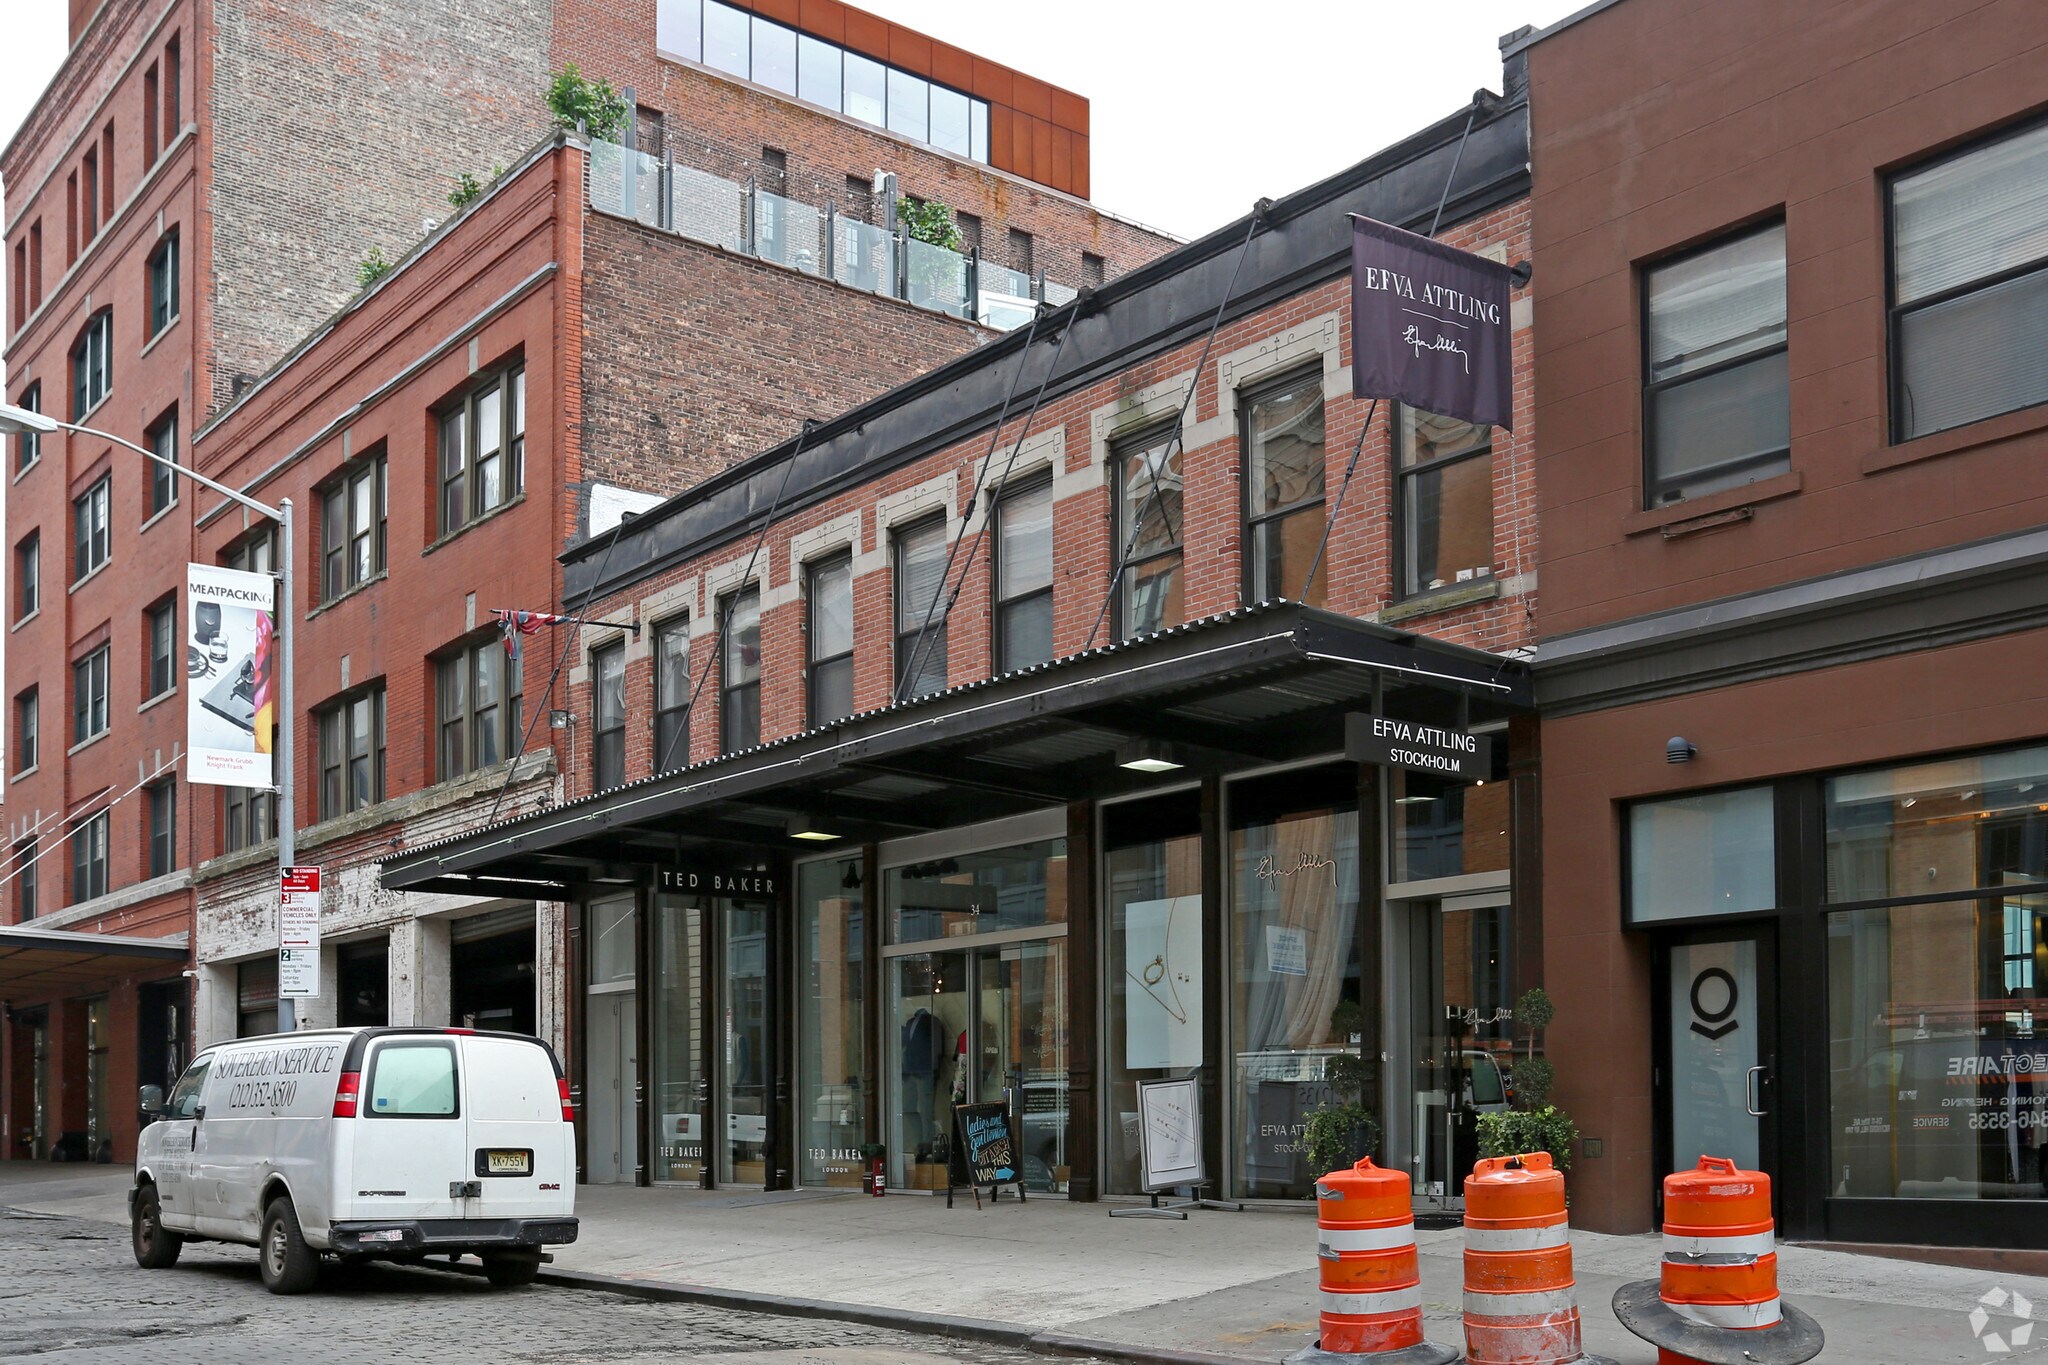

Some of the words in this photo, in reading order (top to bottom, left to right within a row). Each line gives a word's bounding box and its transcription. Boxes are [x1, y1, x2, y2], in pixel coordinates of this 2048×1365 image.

[1365, 266, 1415, 300] EFVA
[1421, 282, 1501, 325] ATTLING
[189, 583, 272, 604] MEATPACKING
[1373, 718, 1412, 742] EFVA
[1415, 726, 1476, 753] ATTLING
[206, 761, 226, 769] Knight
[1390, 748, 1460, 772] STOCKHOLM
[663, 871, 698, 887] TED
[714, 875, 773, 893] BAKER
[283, 893, 290, 903] 3
[970, 904, 980, 916] 34
[283, 950, 289, 960] 2
[214, 1049, 284, 1080] SOVEREIGN
[279, 1045, 340, 1075] SERVICE
[1261, 1125, 1287, 1137] EFVA
[660, 1146, 674, 1157] TED
[808, 1148, 826, 1160] TED
[992, 1151, 1012, 1166] THIS
[975, 1166, 997, 1182] WAY
